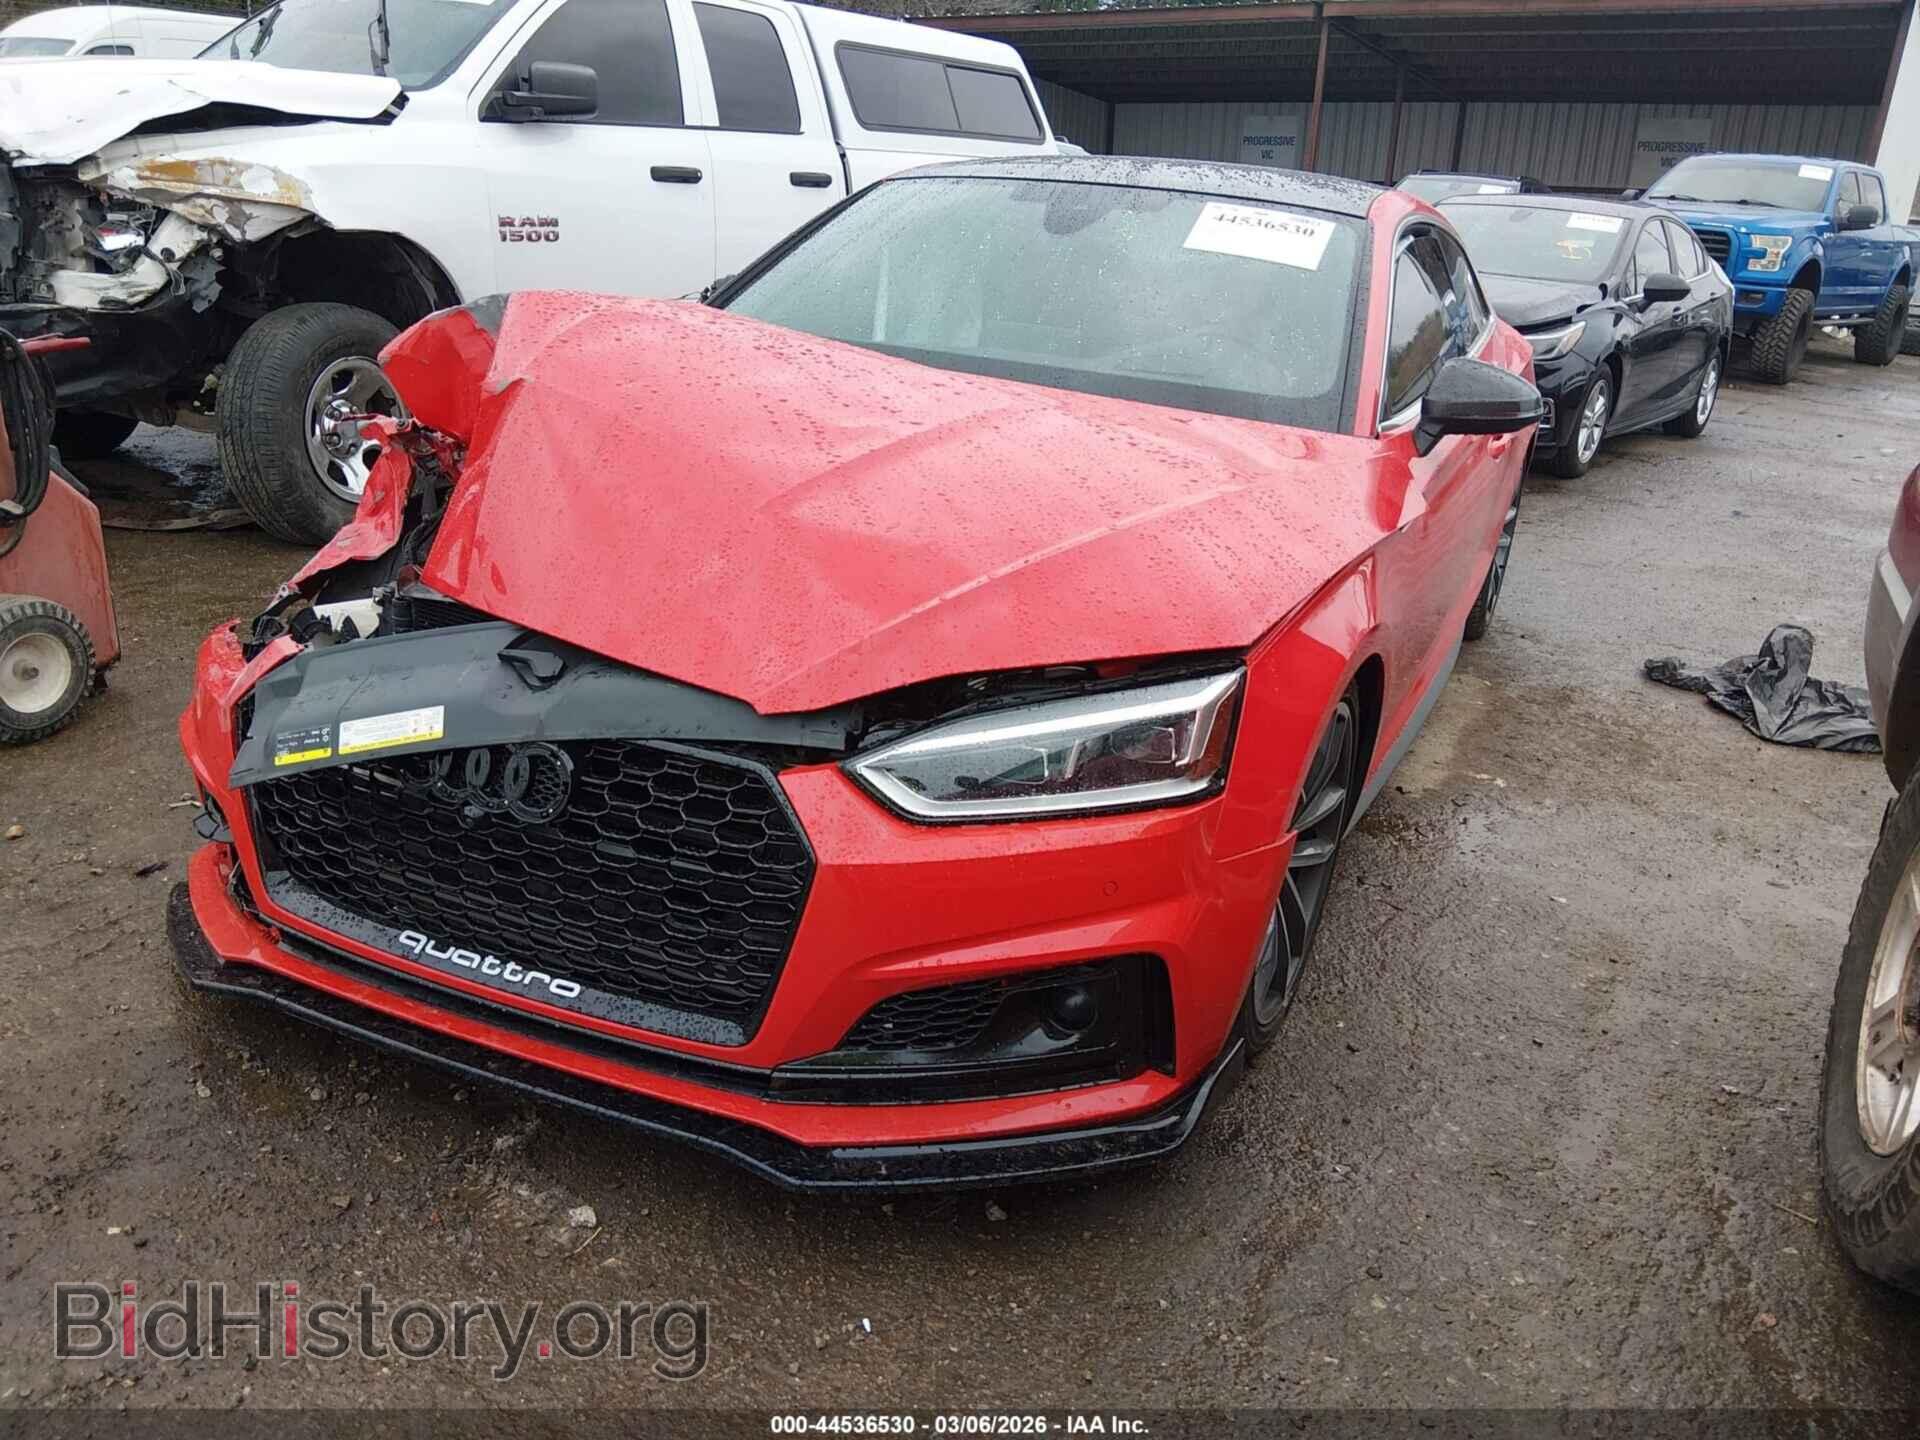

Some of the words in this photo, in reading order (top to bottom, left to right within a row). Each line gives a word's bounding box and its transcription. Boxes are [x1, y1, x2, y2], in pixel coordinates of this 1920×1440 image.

[1242, 135, 1296, 146] PROGRESSIVE
[1638, 141, 1705, 152] PROGRESSIVE
[1260, 149, 1274, 160] VIC
[498, 215, 559, 227] RAM
[1212, 213, 1315, 237] 44536530
[499, 229, 560, 242] 1500
[399, 929, 581, 998] quattro
